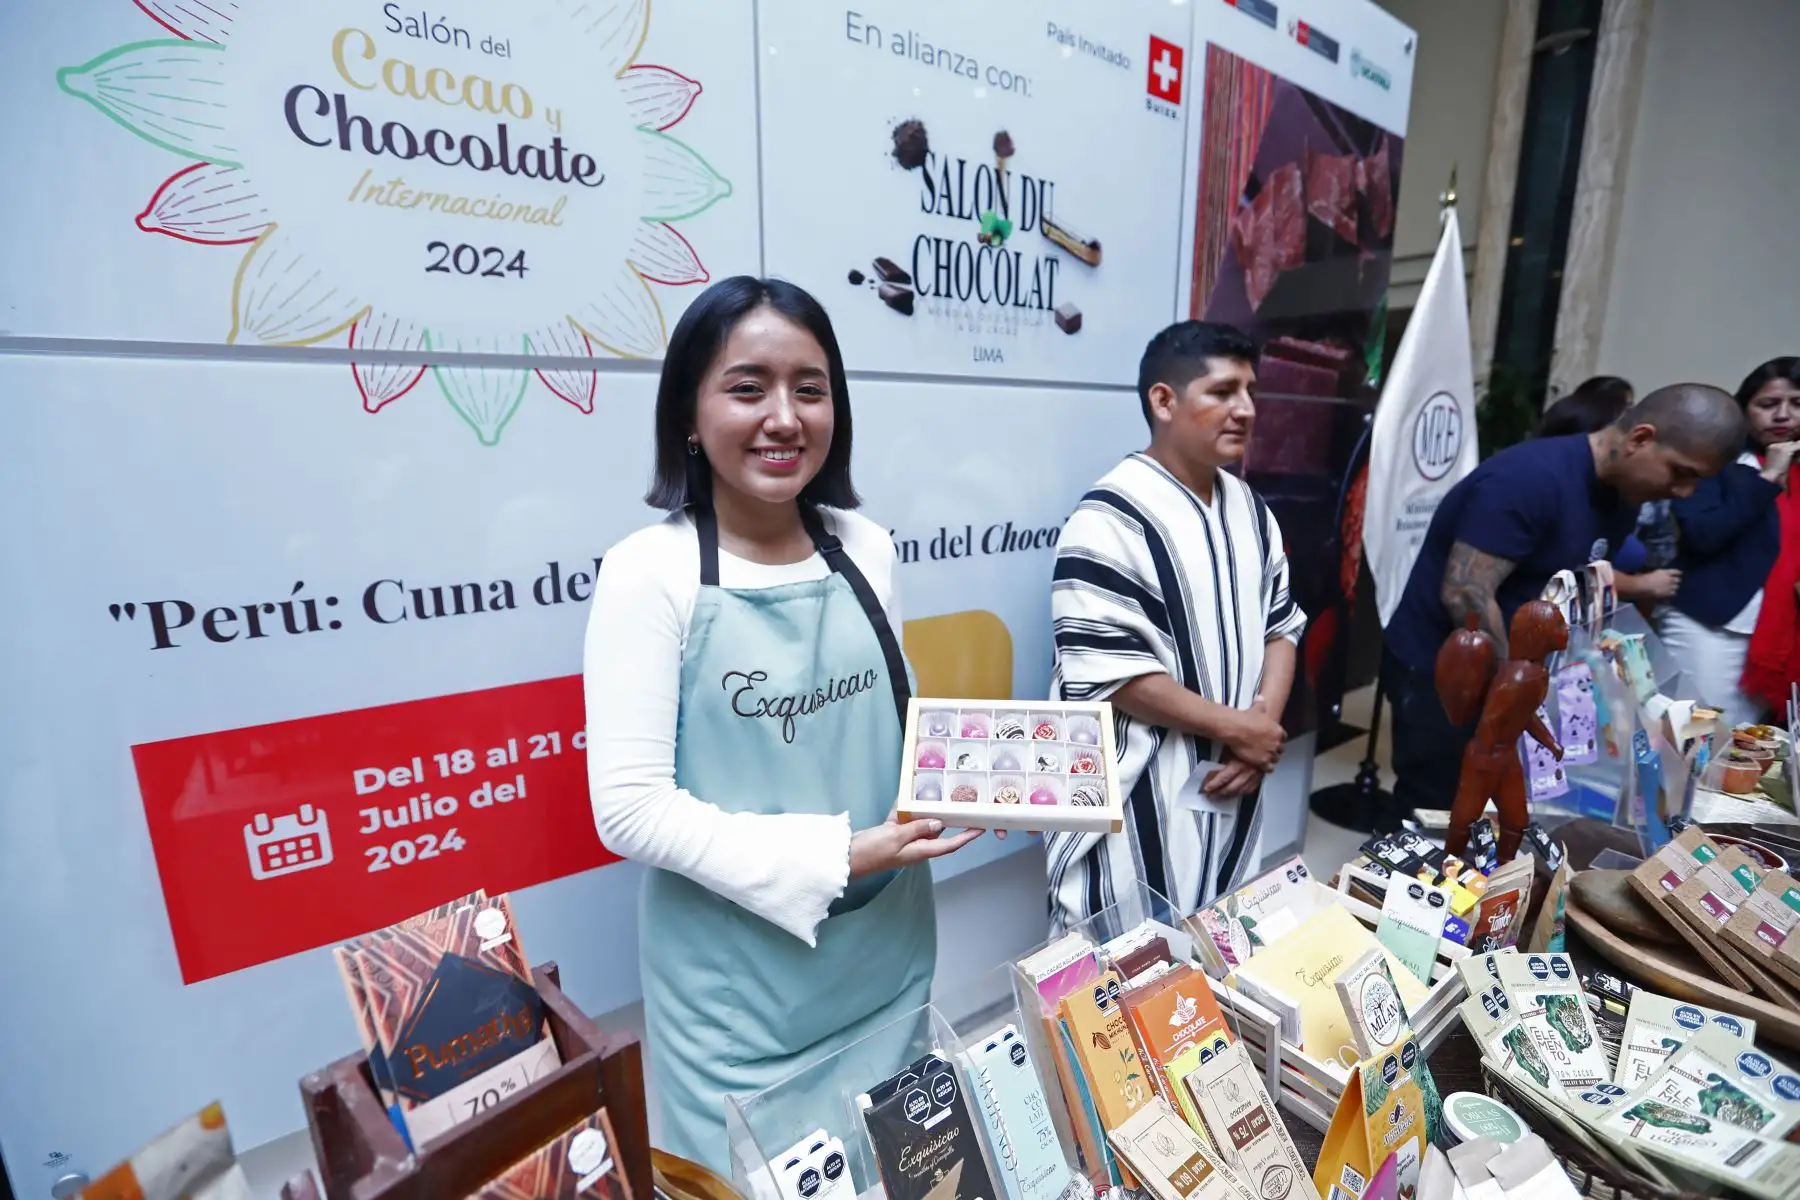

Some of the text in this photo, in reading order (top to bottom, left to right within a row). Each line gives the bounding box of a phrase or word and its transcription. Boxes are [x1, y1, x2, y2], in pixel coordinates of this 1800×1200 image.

[383, 2, 513, 59] Salón del
[845, 10, 1033, 98] En alianza con:
[331, 27, 563, 133] Cacao y
[283, 84, 605, 188] Chocolate
[347, 168, 568, 228] Internacional
[920, 151, 1055, 237] SALON DU
[425, 240, 530, 280] 2024
[912, 234, 1060, 312] CHOCOLAT
[972, 346, 1004, 364] LIMA
[929, 525, 973, 561] del
[981, 517, 1070, 555] Choco
[108, 580, 343, 651] "Perú:
[362, 577, 517, 627] Cuna
[721, 669, 878, 744] Exquisicao
[353, 725, 588, 796] Del 18 al 21 d
[358, 774, 526, 836] Julio del
[364, 828, 468, 875] 2024
[1172, 1015, 1207, 1042] CHOCOLATE
[1370, 1000, 1399, 1036] MILAN
[1534, 1029, 1557, 1041] ELE
[1537, 1040, 1563, 1051] MEN
[936, 1084, 945, 1093] ALTO
[1637, 1063, 1652, 1076] EL
[909, 1099, 918, 1108] ALTO
[899, 1126, 960, 1172] Exquisicao
[1238, 1124, 1250, 1140] 75
